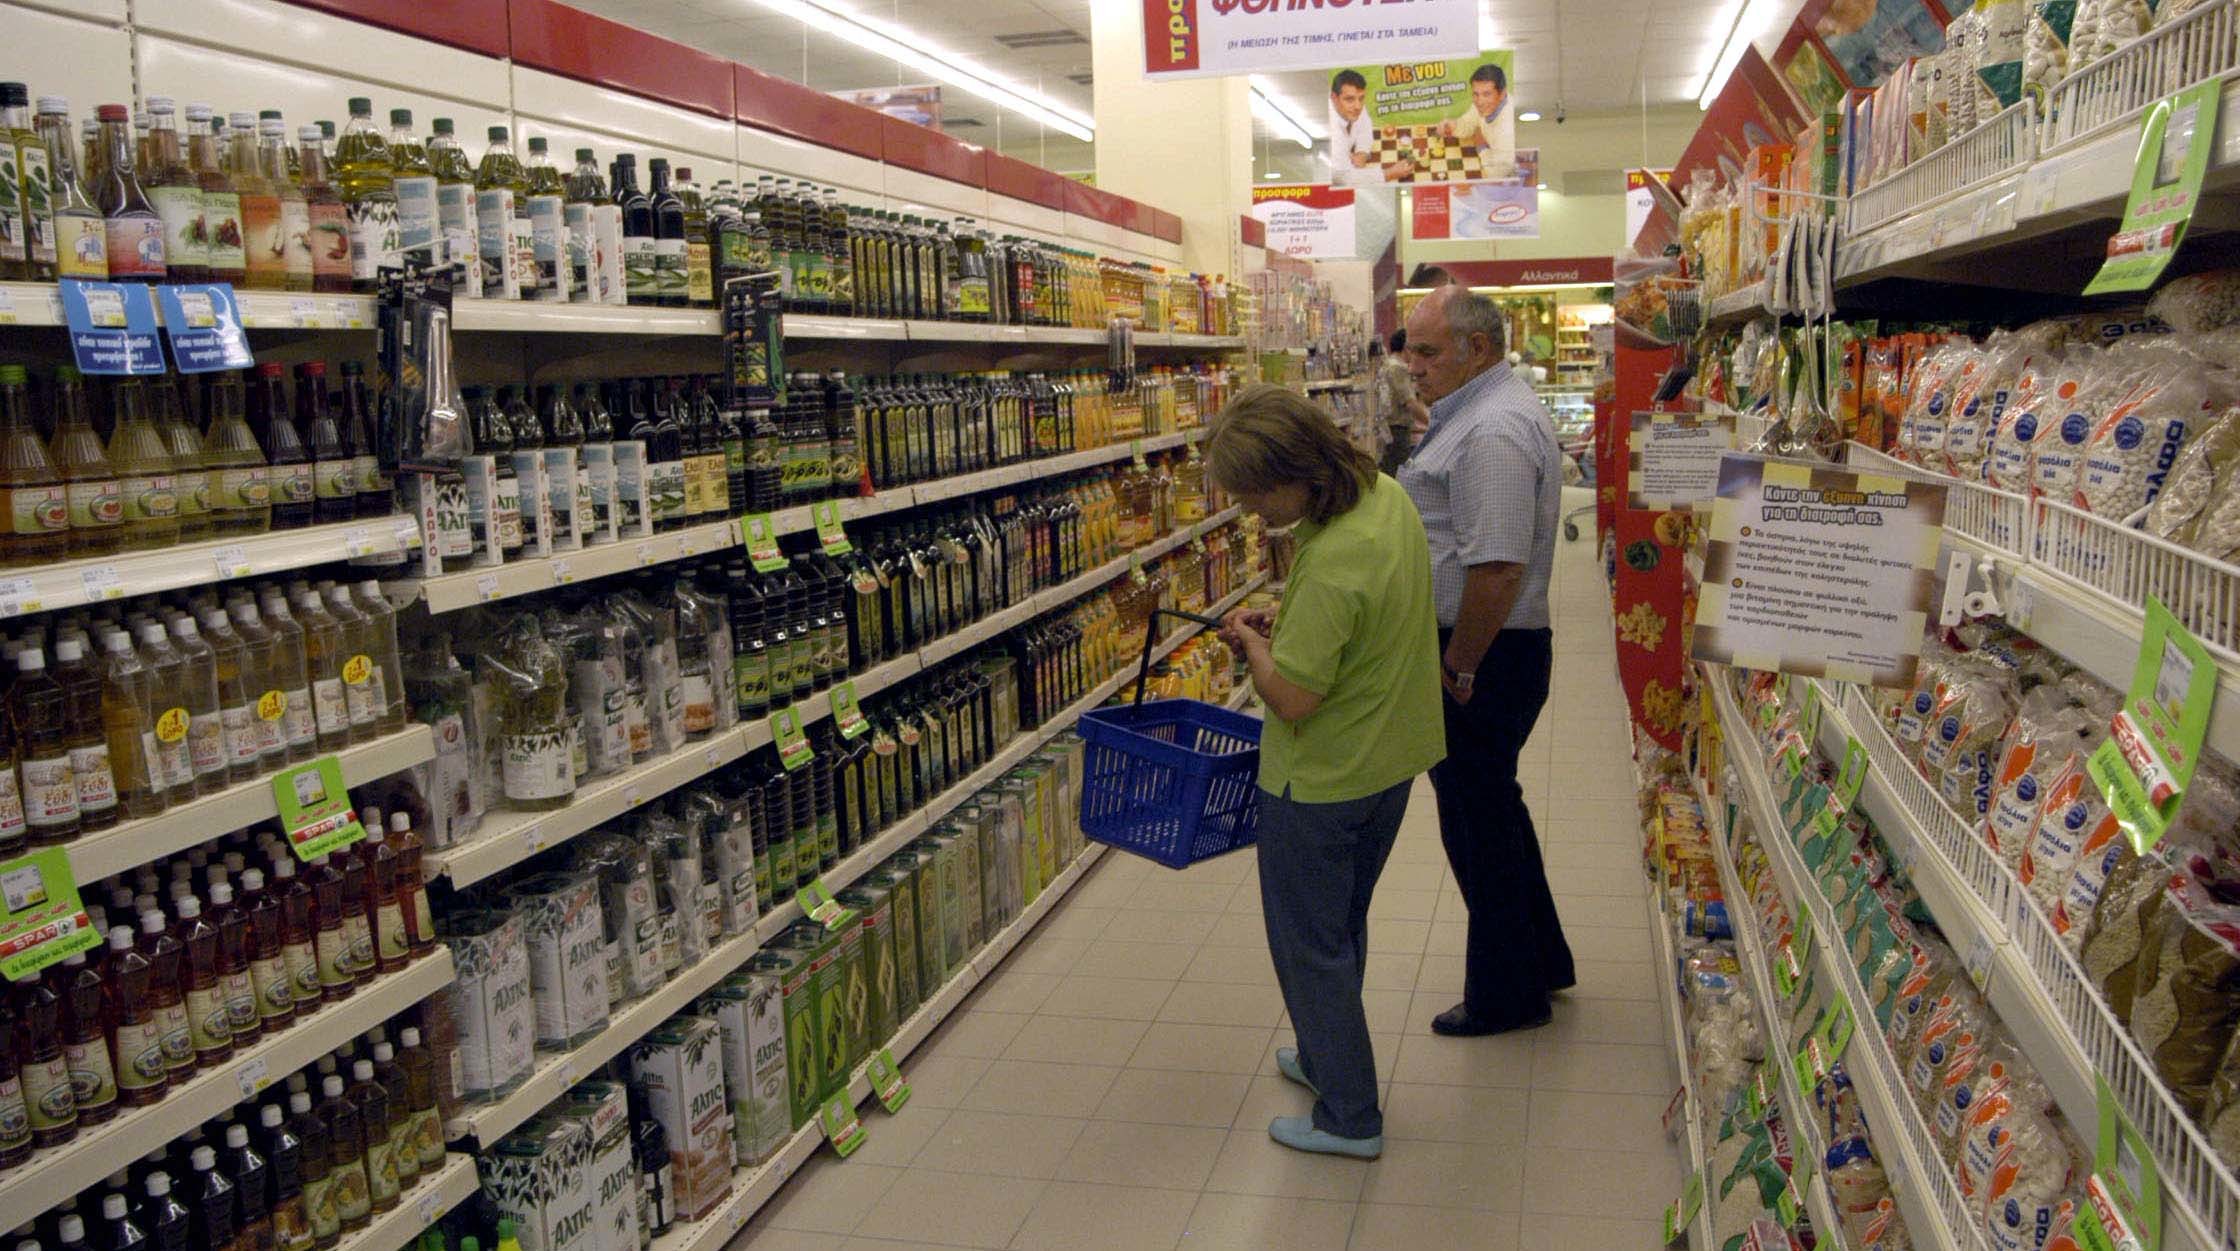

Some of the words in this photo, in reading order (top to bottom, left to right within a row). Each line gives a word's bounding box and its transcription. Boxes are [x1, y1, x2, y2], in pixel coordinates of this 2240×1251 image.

[1240, 37, 1279, 49] ΜΕΙΩΣΗ
[1281, 36, 1301, 46] ΤΗΣ
[1337, 30, 1375, 42] ΓΙΝΕΤΑΙ
[1377, 29, 1395, 40] ΣΤΑ
[1398, 26, 1439, 38] ΤΑΜΕΙΑ)
[1521, 269, 1579, 282] Αλλαντικά
[1763, 485, 1799, 502] Κάντε
[1800, 489, 1821, 503] την
[1867, 491, 1908, 508] κίνηση
[1763, 506, 1782, 522] για
[1784, 507, 1798, 521] τη
[1800, 506, 1855, 526] διατροφή
[1856, 511, 1883, 526] σας.
[426, 507, 438, 557] ΔΩΡΟ
[304, 820, 336, 839] SPAR
[14, 923, 58, 950] SPAR
[2091, 1195, 2122, 1246] SPAR
